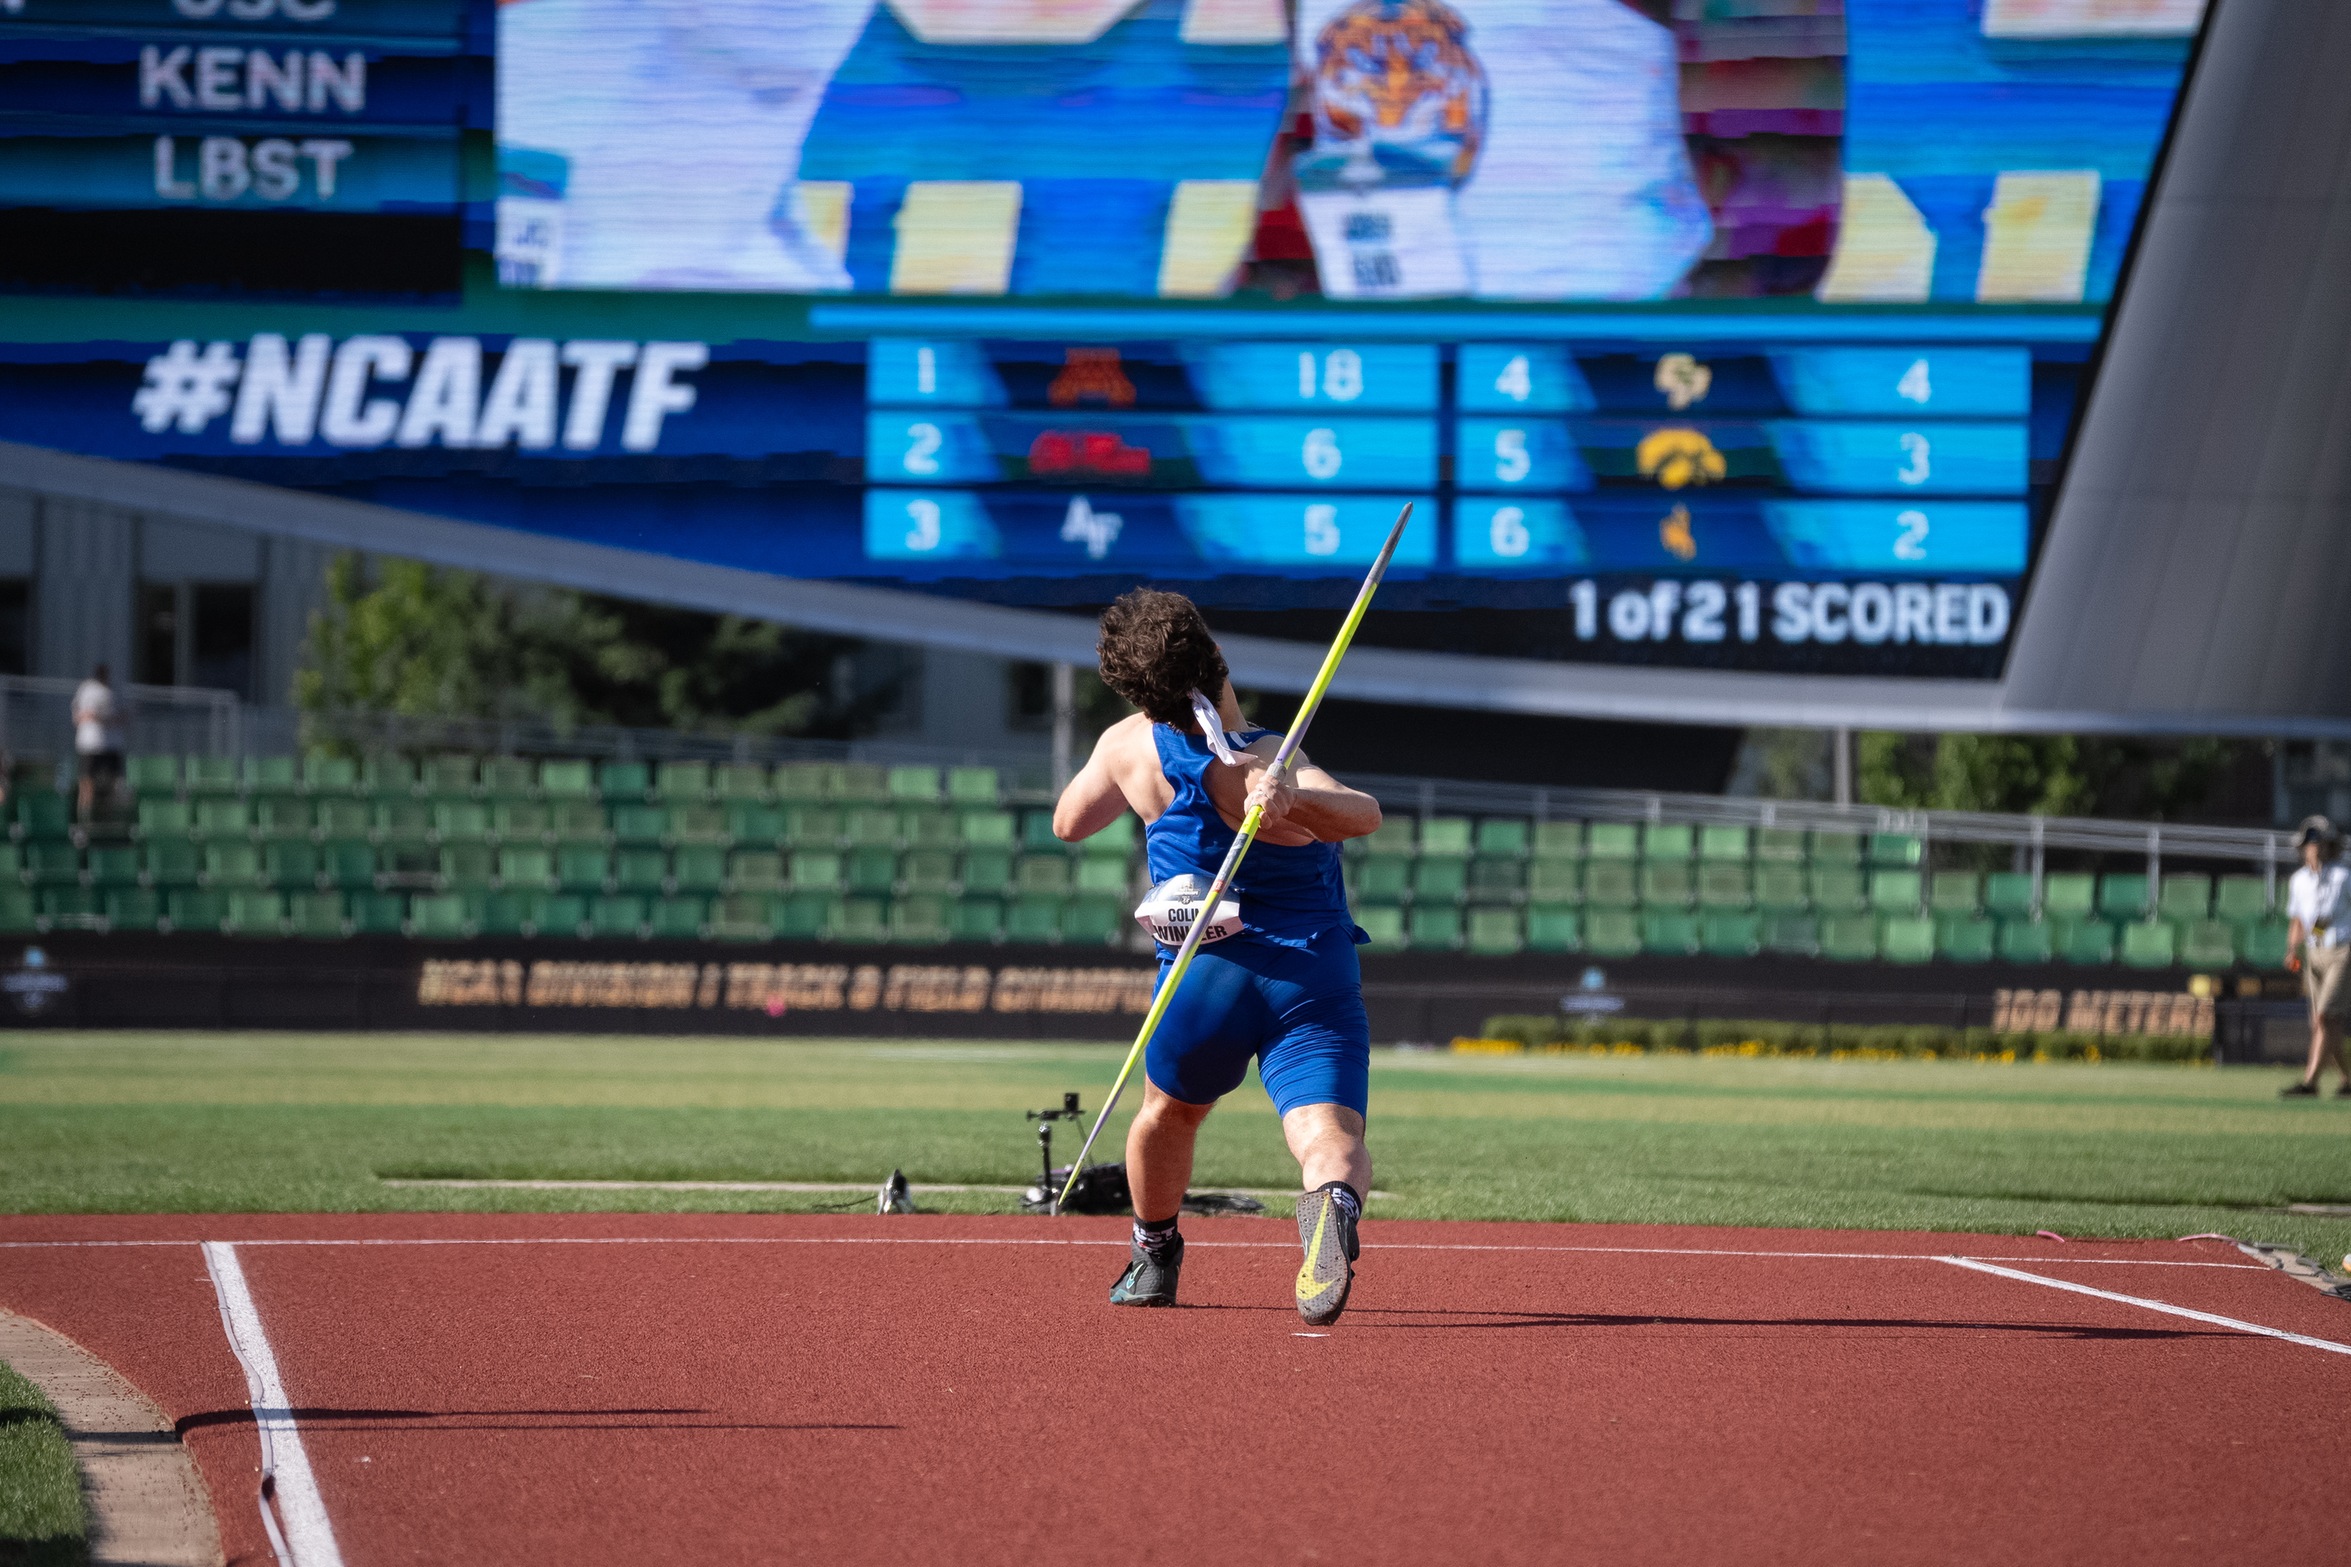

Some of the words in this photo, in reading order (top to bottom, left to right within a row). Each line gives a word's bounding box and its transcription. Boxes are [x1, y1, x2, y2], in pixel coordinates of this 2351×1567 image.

[139, 45, 366, 113] KENN
[153, 135, 353, 200] LBST
[131, 333, 708, 449] #NCAATF
[917, 347, 936, 394] 1
[1298, 349, 1364, 401] 18
[1495, 355, 1531, 401] 4
[1897, 358, 1932, 404] 4
[903, 423, 942, 474] 2
[1302, 428, 1342, 479] 6
[1494, 429, 1531, 482] 5
[1897, 432, 1931, 485] 3
[904, 499, 941, 551] 3
[1304, 504, 1340, 556] 5
[1490, 507, 1530, 557] 6
[1893, 510, 1929, 561] 2
[1569, 580, 1597, 641] 1
[1607, 580, 1681, 642] of
[1681, 581, 1761, 642] 21
[1771, 582, 2011, 645] SCORED
[1153, 925, 1227, 941] WINER
